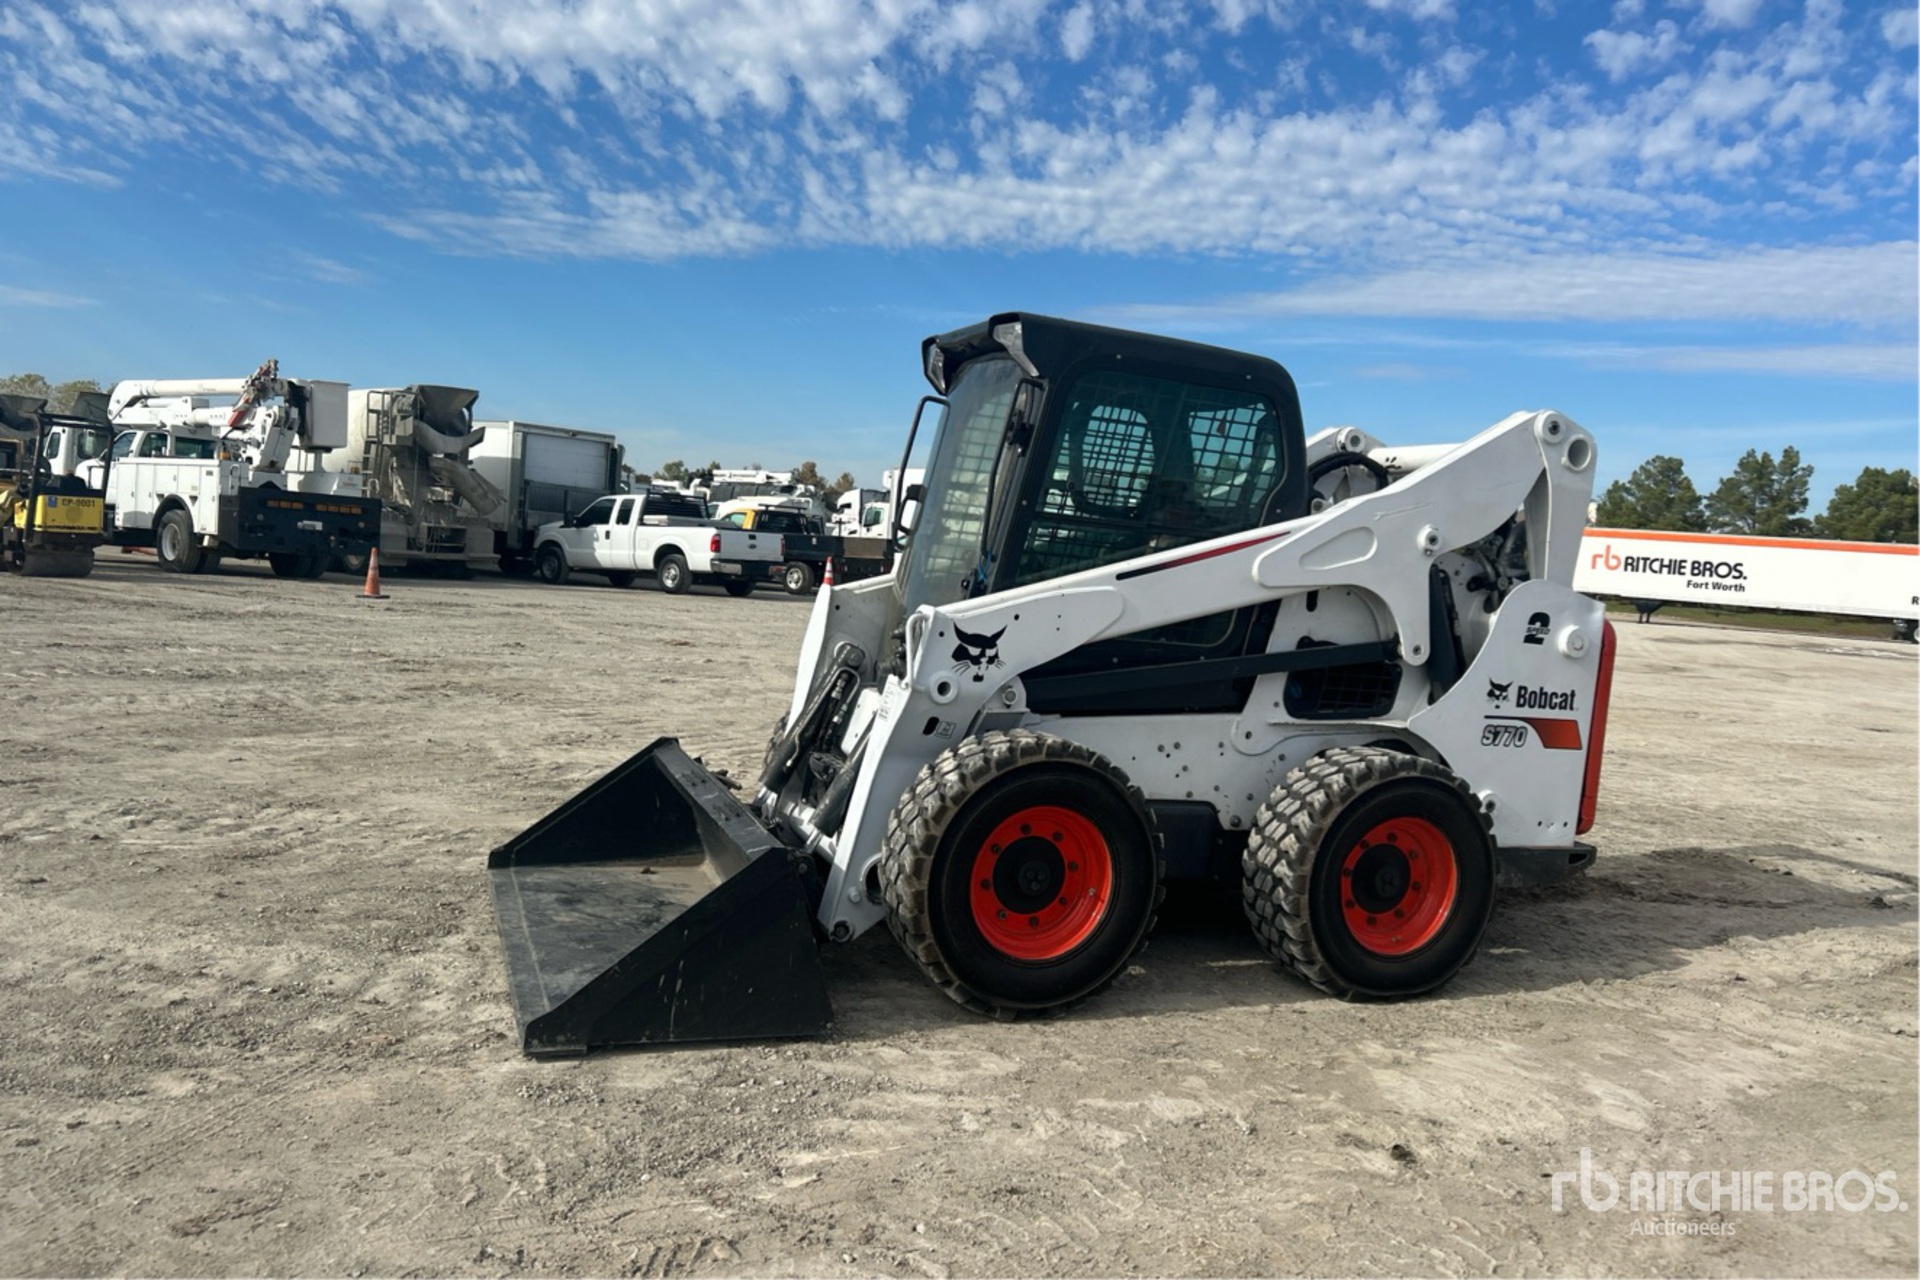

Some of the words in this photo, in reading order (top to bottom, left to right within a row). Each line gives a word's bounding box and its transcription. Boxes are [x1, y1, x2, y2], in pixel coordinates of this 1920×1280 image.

[1623, 556, 1687, 576] RITCHIE
[1690, 560, 1747, 580] BROS.
[1686, 580, 1709, 590] Fort
[1711, 582, 1746, 592] Worth
[1523, 612, 1550, 645] 2
[1525, 626, 1551, 635] SPEED
[1516, 686, 1576, 711] Bobcat
[1481, 724, 1528, 747] S770
